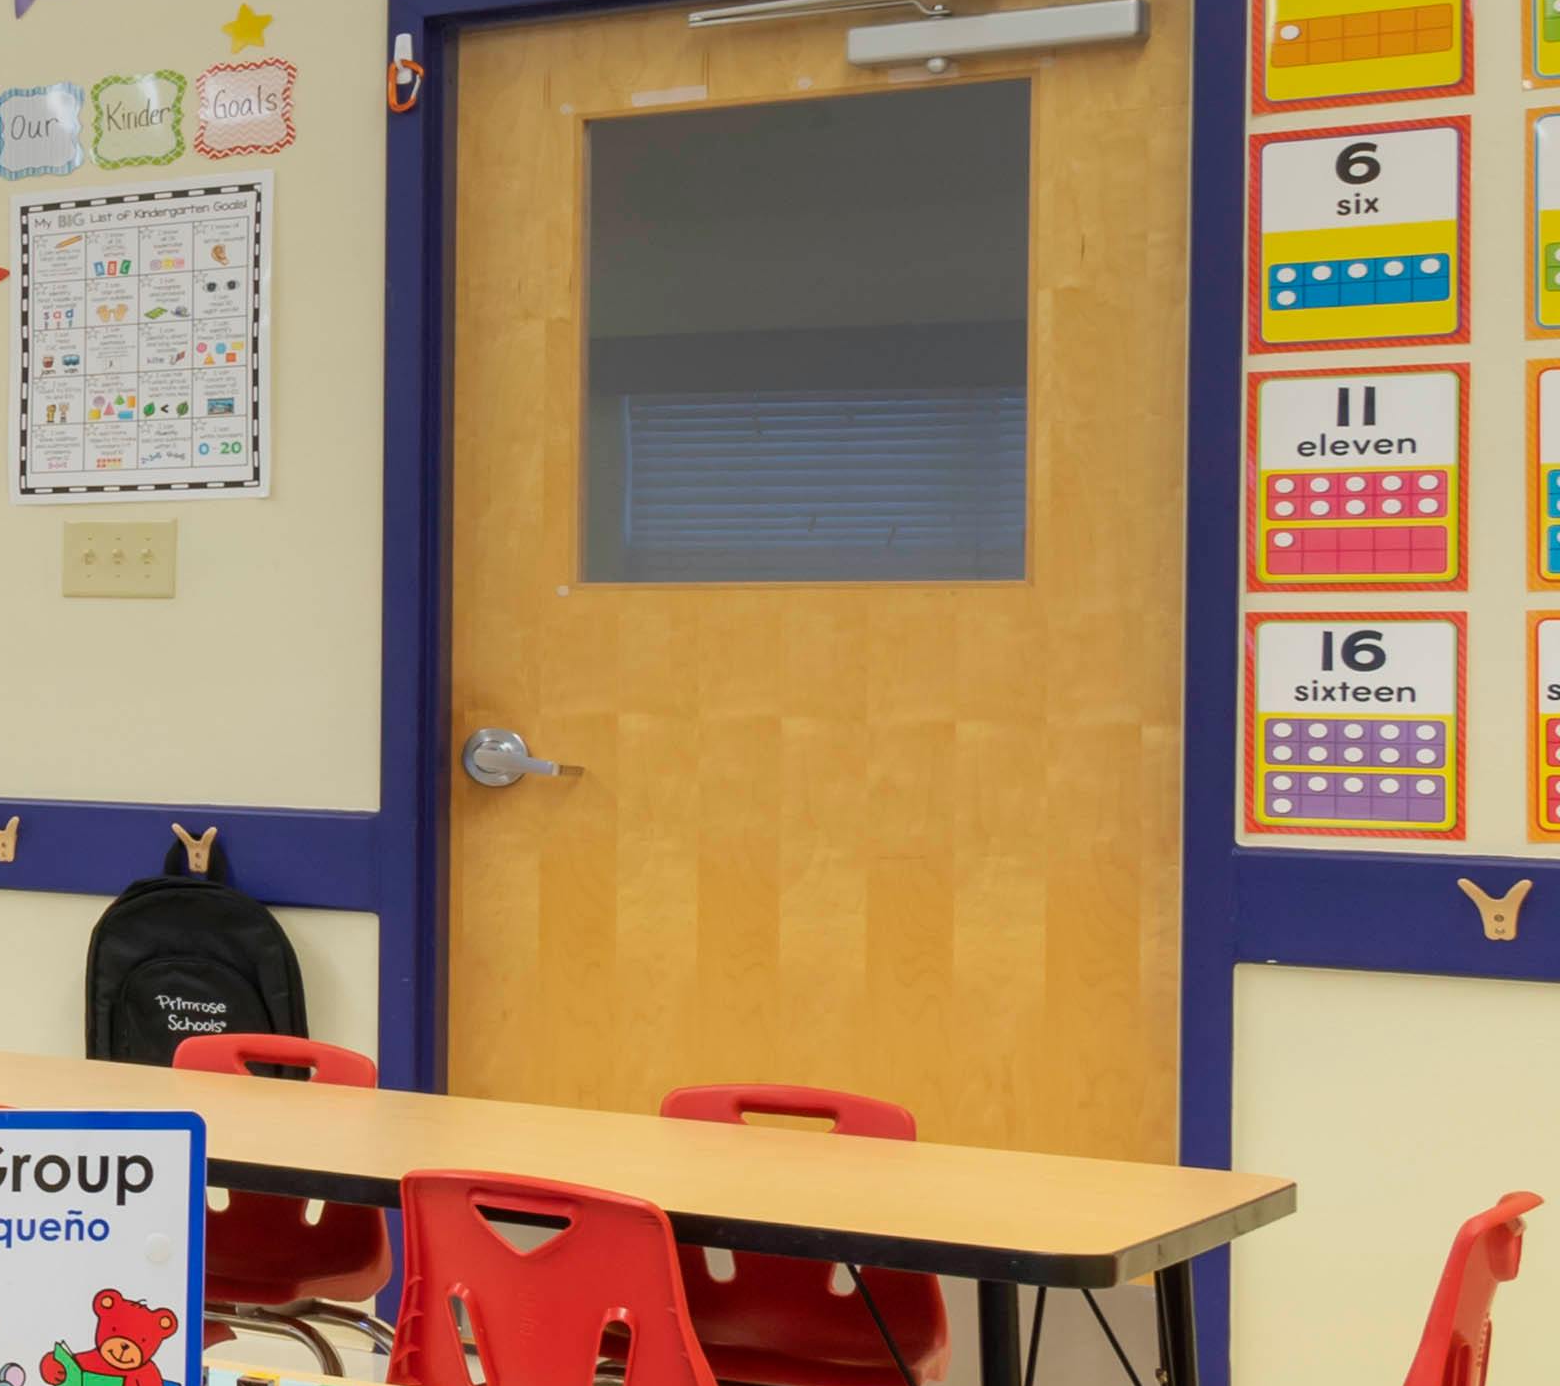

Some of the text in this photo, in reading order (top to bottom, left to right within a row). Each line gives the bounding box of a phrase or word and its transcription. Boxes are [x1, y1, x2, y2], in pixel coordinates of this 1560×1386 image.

[10, 85, 278, 141] Our Kinder Goals
[1335, 141, 1381, 185] 6
[1336, 192, 1379, 216] six
[34, 218, 51, 229] My
[58, 214, 85, 228] BIG
[91, 213, 113, 223] List
[117, 211, 130, 221] of
[134, 204, 209, 218] Kindergarten
[1297, 433, 1417, 457] eleven
[1321, 629, 1387, 673] 16
[1294, 679, 1417, 703] sixteen
[154, 994, 227, 1014] Primrose
